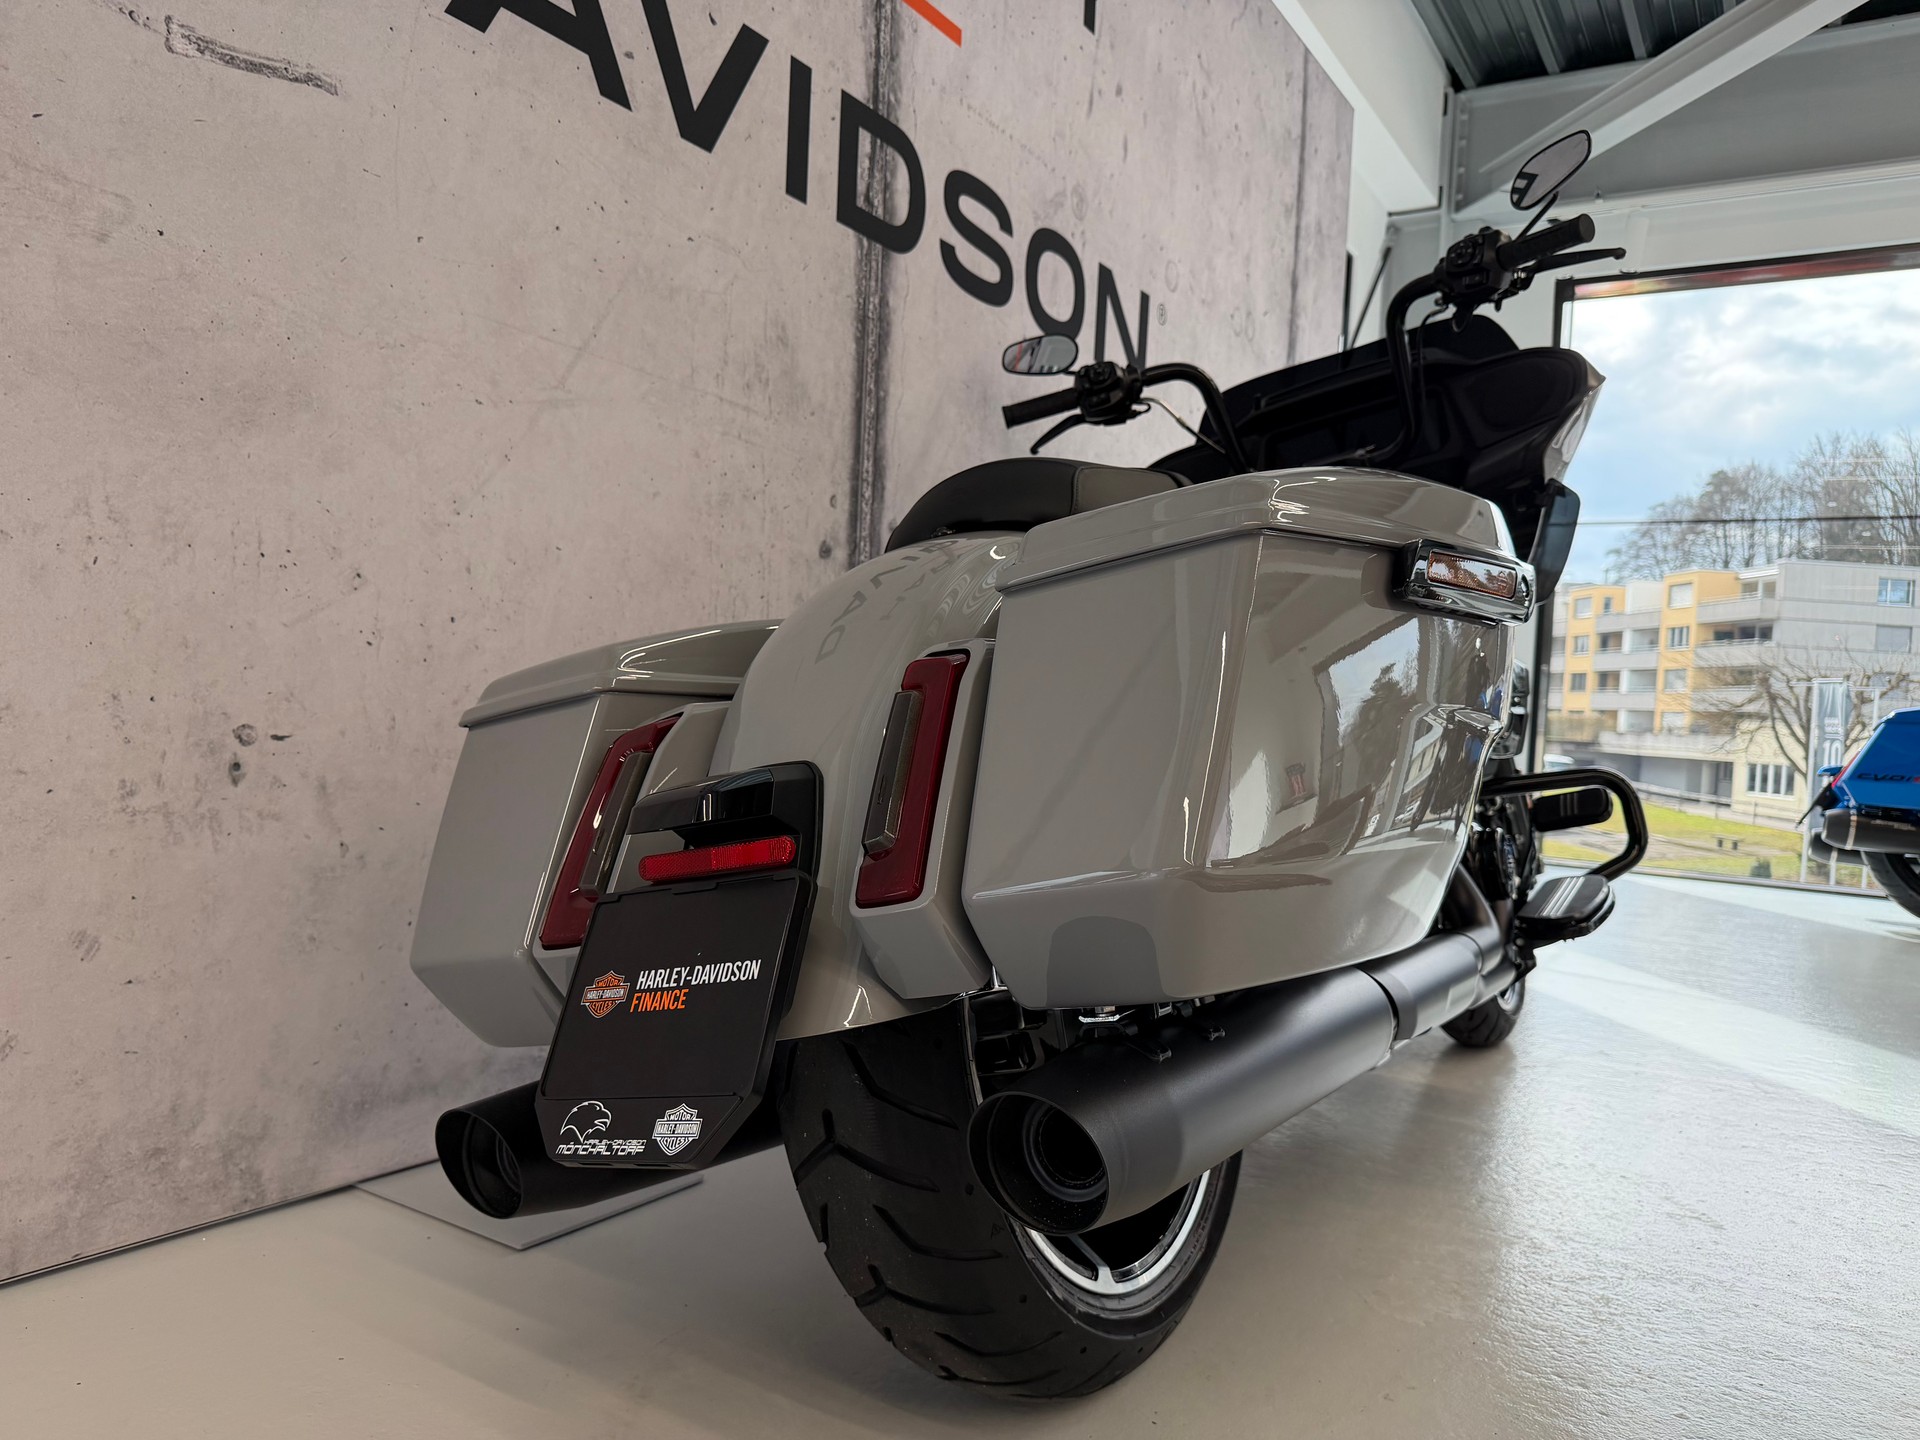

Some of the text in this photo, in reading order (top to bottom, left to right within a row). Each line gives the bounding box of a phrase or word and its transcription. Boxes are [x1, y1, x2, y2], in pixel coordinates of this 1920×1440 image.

[636, 959, 761, 990] HARLEY-DAVIDSON
[598, 977, 619, 987] MOTOR
[586, 988, 625, 1000] HARLEY-DAVIDSON
[630, 988, 689, 1013] FINANCE
[592, 1001, 613, 1014] CYCLES
[669, 1110, 692, 1121] MOTOR
[656, 1123, 698, 1134] HARLEY-DAVIDSON
[663, 1137, 685, 1150] CYCLES
